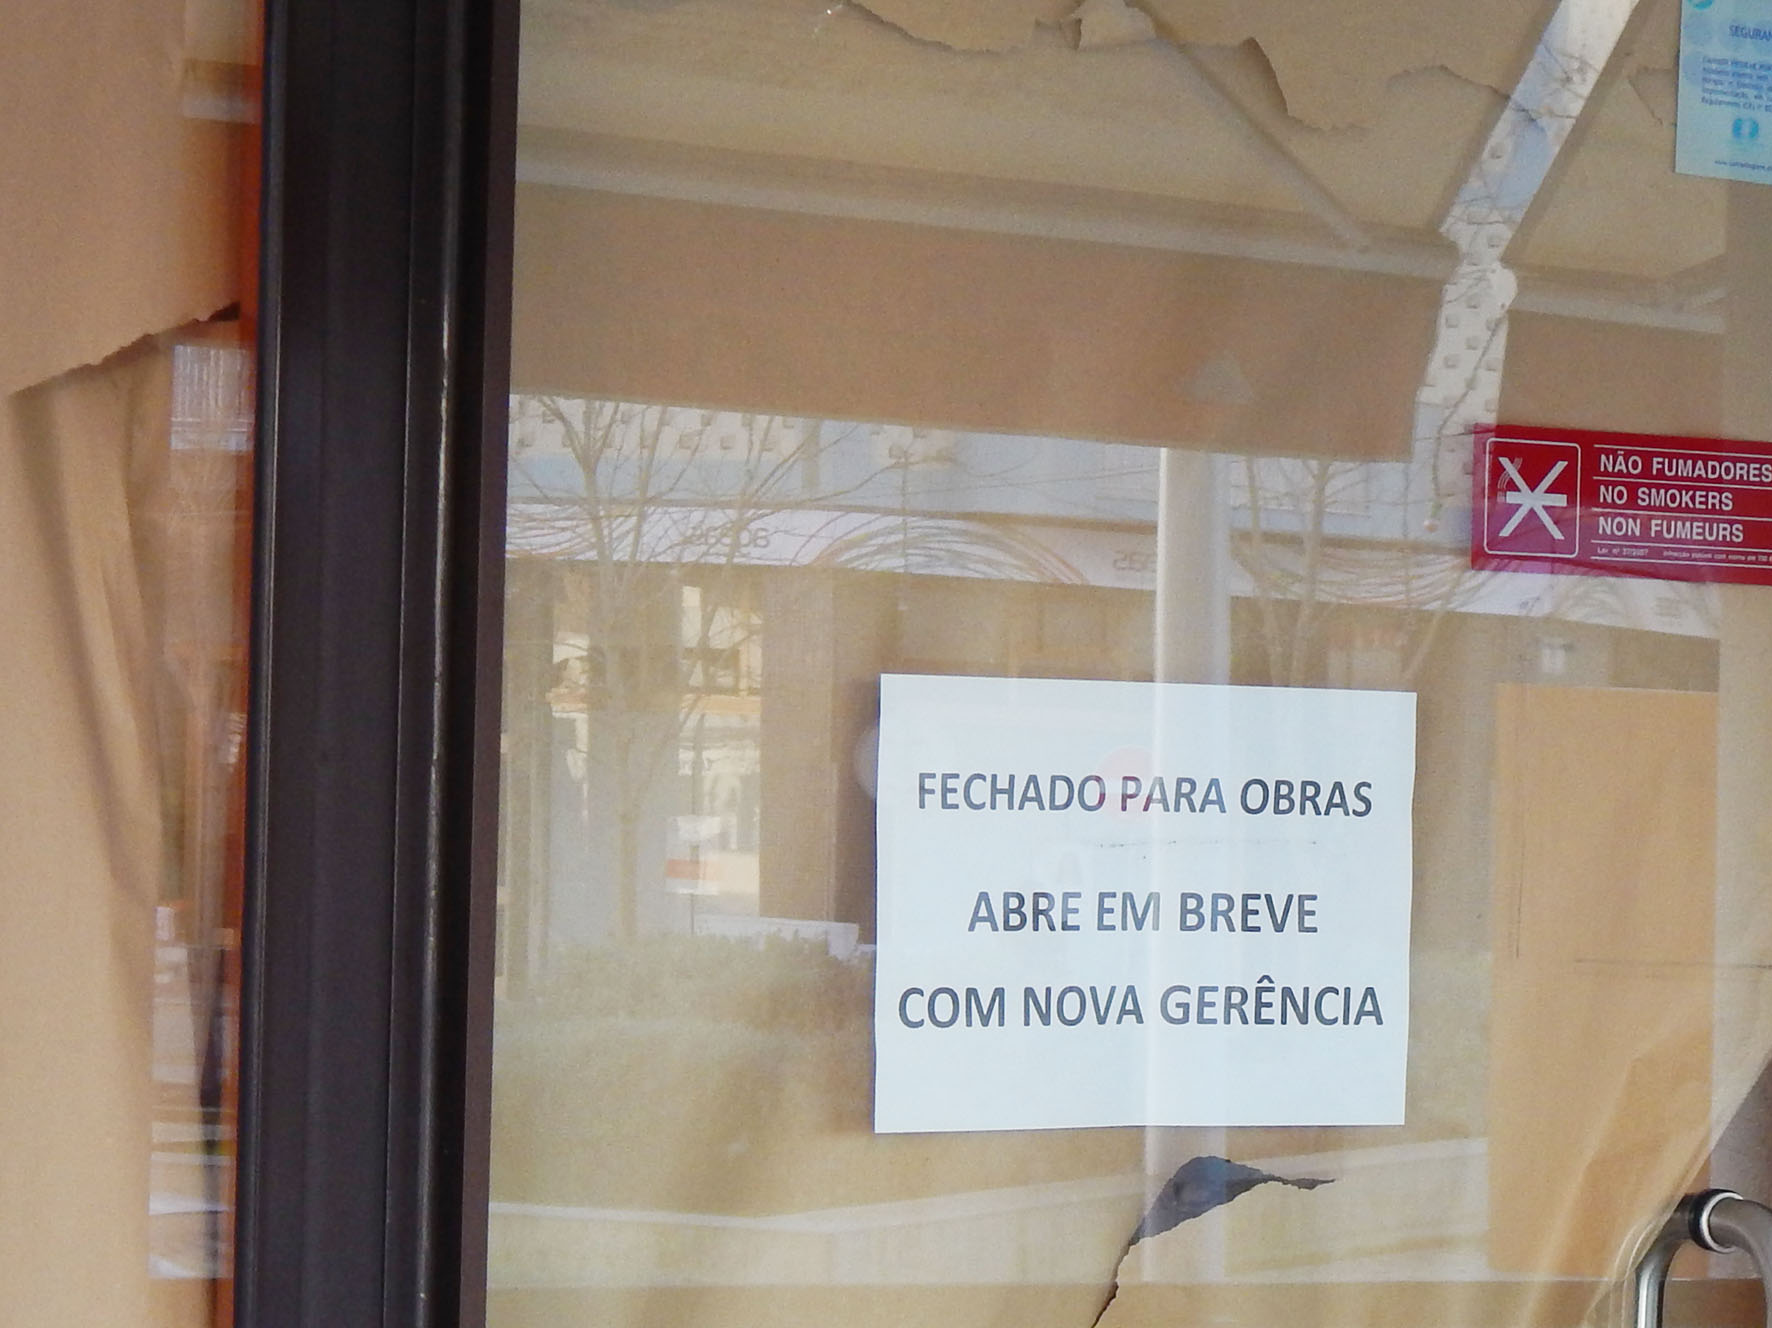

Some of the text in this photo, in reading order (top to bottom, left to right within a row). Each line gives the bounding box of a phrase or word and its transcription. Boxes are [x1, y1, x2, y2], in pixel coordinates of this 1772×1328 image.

[1599, 450, 1643, 475] NÃO
[1599, 485, 1734, 511] NO SMOKERS
[1598, 516, 1745, 543] NON FUMEURS
[917, 772, 1374, 817] FECHADO PARA OBRAS
[967, 890, 1319, 933] ABRE EM BREVE
[898, 974, 1385, 1029] COM NOVA GERÊNCIA
